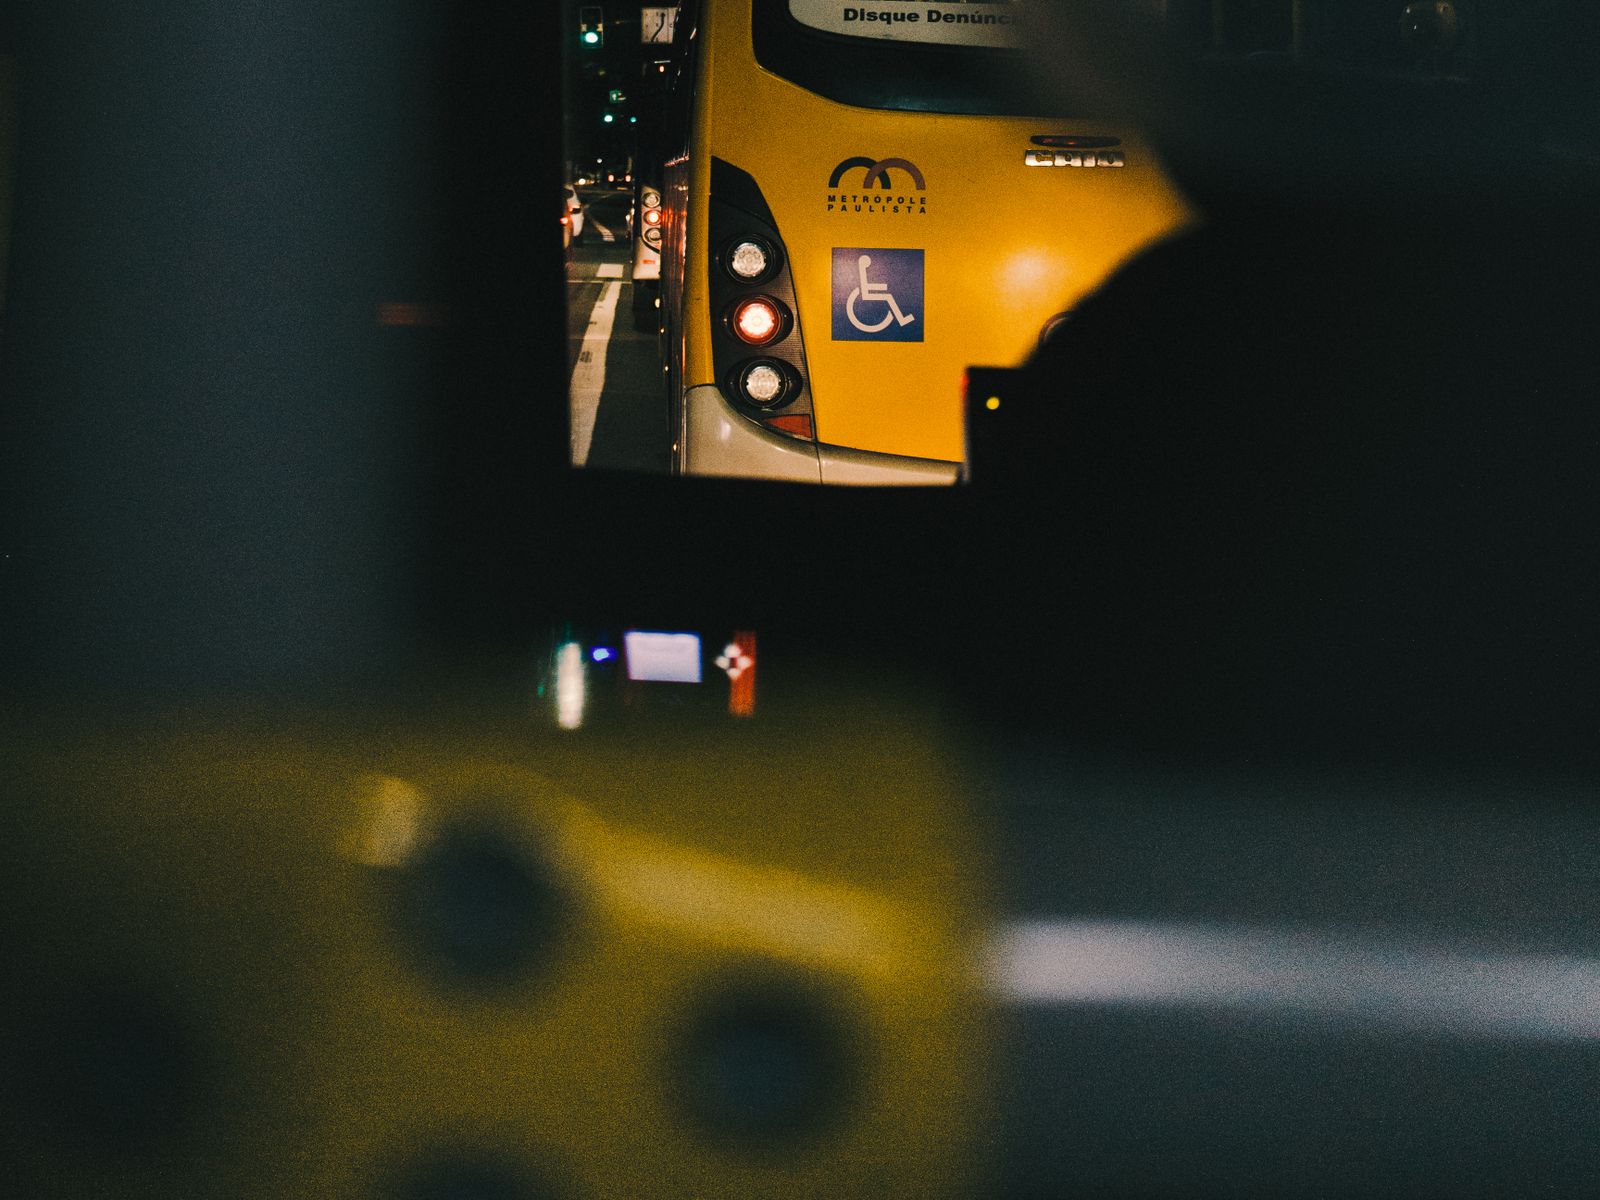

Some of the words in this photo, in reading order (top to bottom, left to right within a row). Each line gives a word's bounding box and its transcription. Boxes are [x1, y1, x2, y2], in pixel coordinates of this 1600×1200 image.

[843, 8, 920, 25] Disque
[927, 9, 1016, 25] Denúnc
[827, 204, 926, 214] PAULISTA
